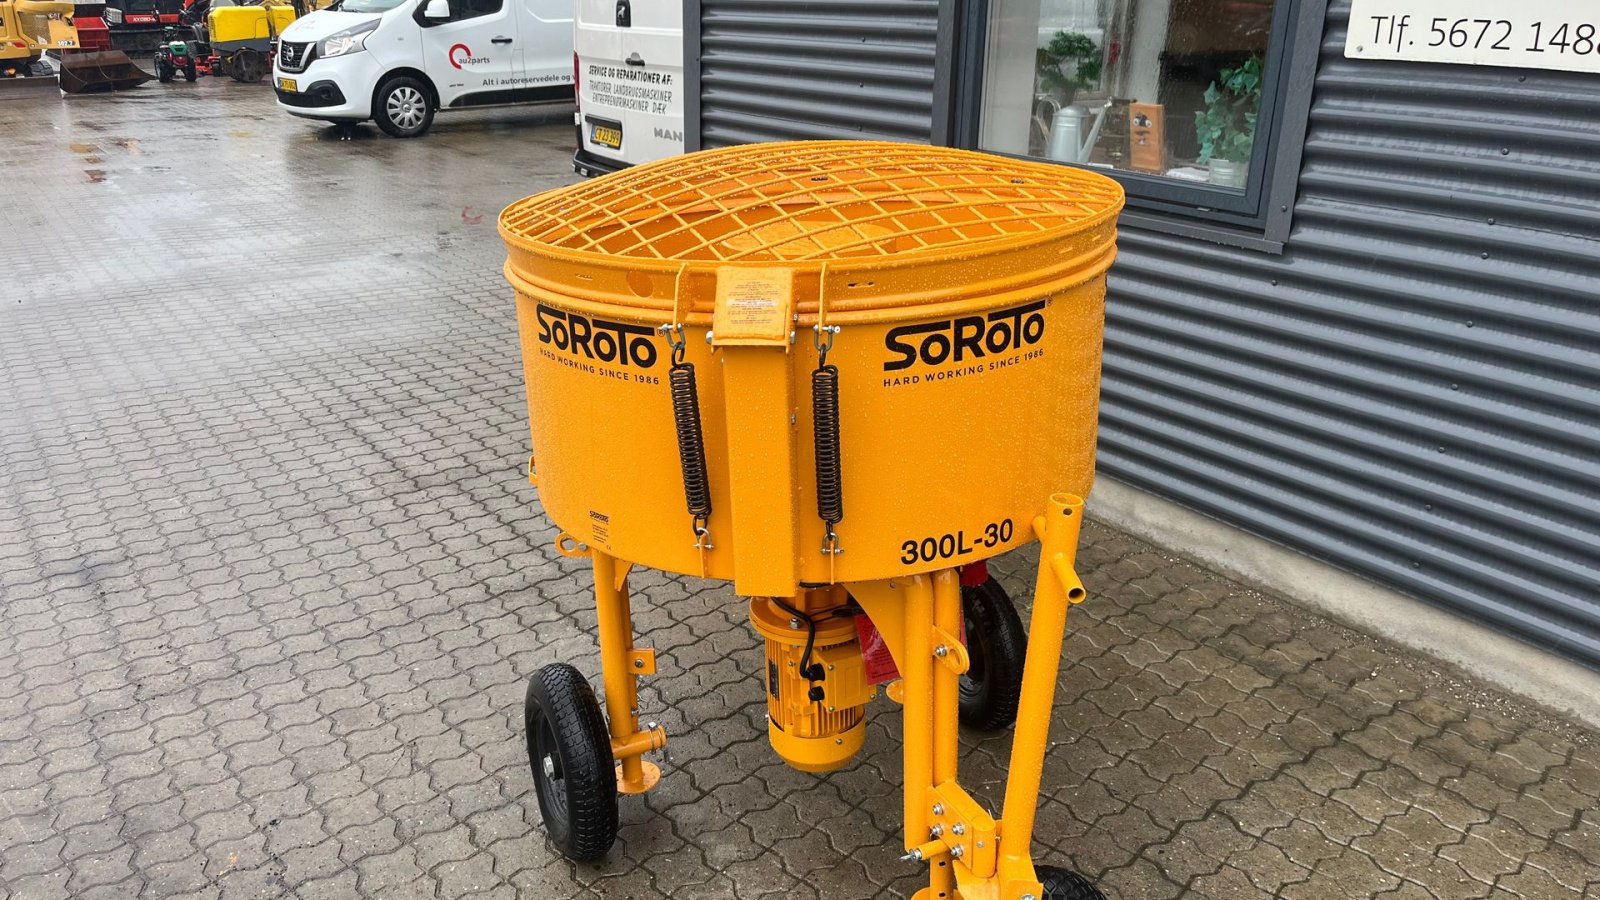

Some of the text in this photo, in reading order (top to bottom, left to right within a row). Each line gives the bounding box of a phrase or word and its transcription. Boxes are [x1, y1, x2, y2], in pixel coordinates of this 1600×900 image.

[1371, 15, 1600, 56] Tlf. 5672 148
[458, 57, 491, 66] au2parts
[482, 78, 495, 87] Alt
[500, 74, 560, 85] autoreservedele
[561, 74, 571, 82] og
[588, 65, 608, 77] SERVICE
[608, 67, 615, 78] OG
[616, 68, 661, 85] REPARATIONER
[661, 74, 673, 85] AF:
[613, 83, 673, 103] LANDBRUGSMASKINER
[652, 102, 667, 115] DÆK
[654, 127, 683, 142] MAN
[540, 348, 659, 385] HARD WORKING SINCE 1986
[883, 348, 1044, 388] HARD WORKING SINCE 1986
[901, 518, 1013, 565] 300L-30
